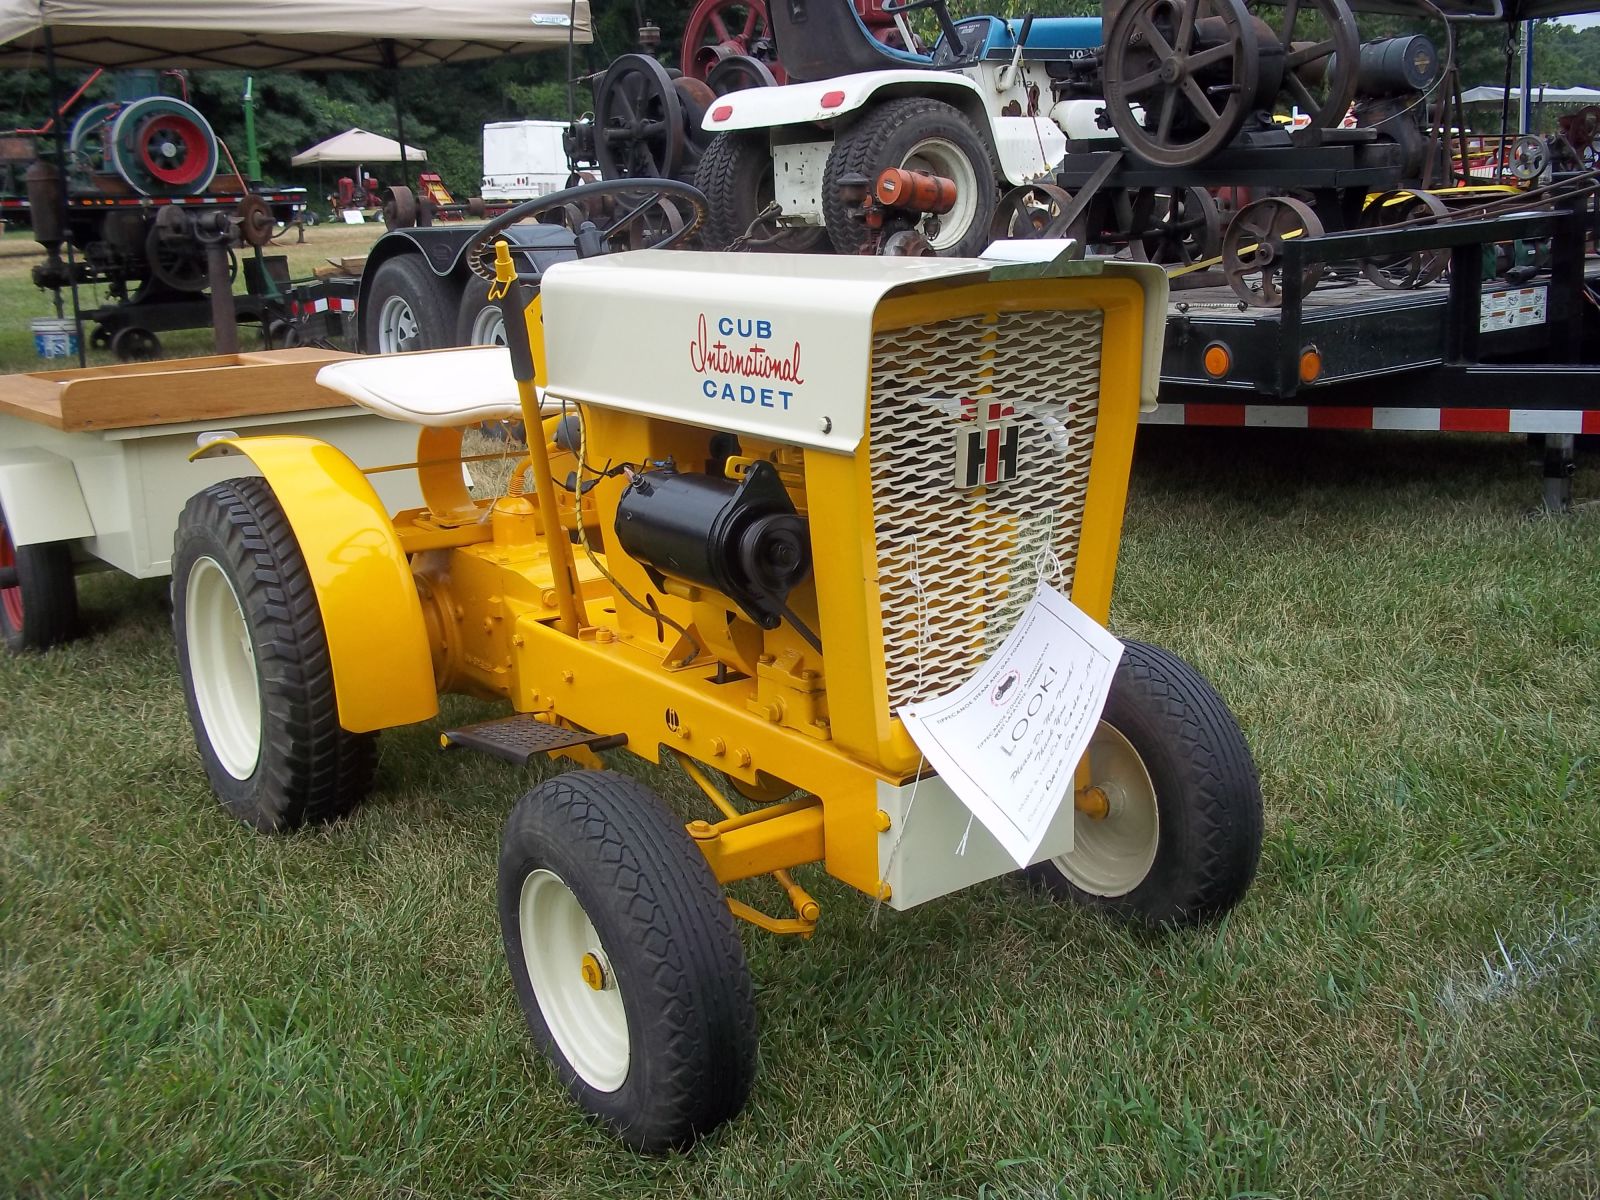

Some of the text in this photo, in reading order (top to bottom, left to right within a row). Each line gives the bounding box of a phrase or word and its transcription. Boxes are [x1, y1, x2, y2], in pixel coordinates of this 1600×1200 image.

[718, 317, 772, 339] CUB
[690, 313, 804, 385] International
[702, 380, 793, 410] CADET
[1010, 635, 1024, 656] POWER
[1000, 666, 1057, 756] LOOK!
[1034, 729, 1053, 761] Thank
[1008, 750, 1033, 784] Please
